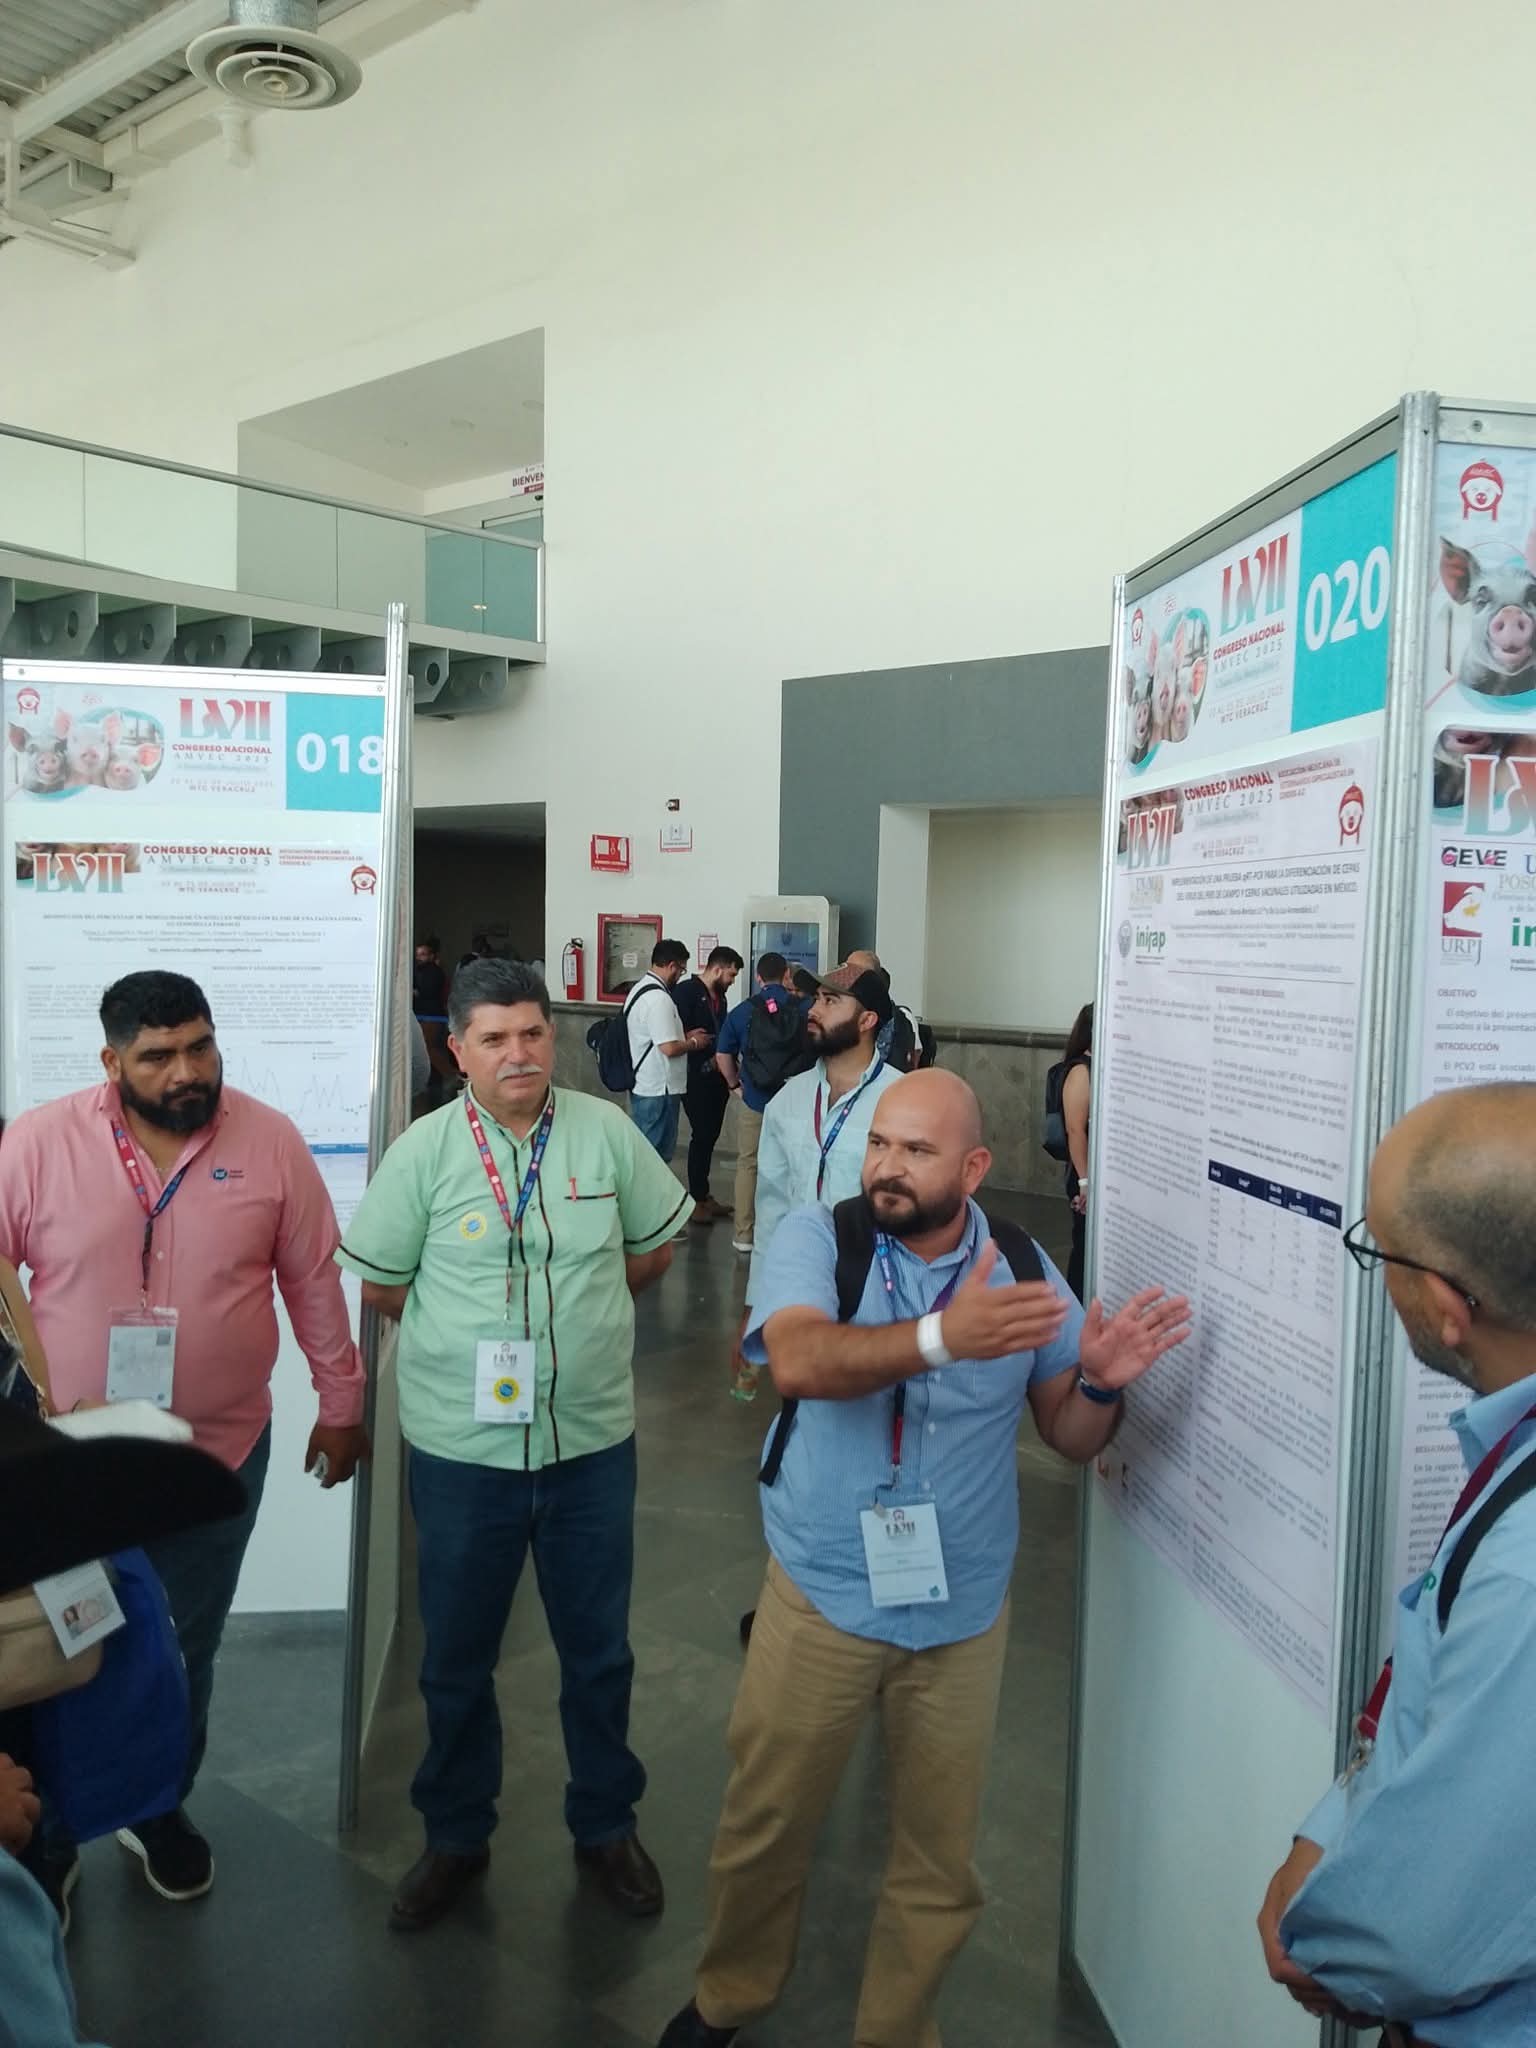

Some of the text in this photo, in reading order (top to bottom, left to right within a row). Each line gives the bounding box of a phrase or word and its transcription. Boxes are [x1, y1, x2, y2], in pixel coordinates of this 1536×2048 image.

[1305, 546, 1391, 652] 020
[1213, 621, 1285, 660] CONGRESO NACIONAL
[1214, 652, 1249, 674] AMVEC
[172, 744, 273, 755] CONGRESO NACIONAL
[174, 753, 225, 761] AMVEC
[296, 732, 384, 776] 018
[1184, 771, 1274, 801] CONGRESO NACIONAL
[1240, 789, 1273, 808] 2025
[143, 845, 207, 855] CONGRESO
[211, 846, 272, 856] NACIONAL
[147, 855, 214, 865] AMVEC
[228, 857, 271, 867] 2025
[1438, 988, 1478, 998] OBJETIVO
[1435, 1041, 1500, 1052] INTRODUCCIÓN
